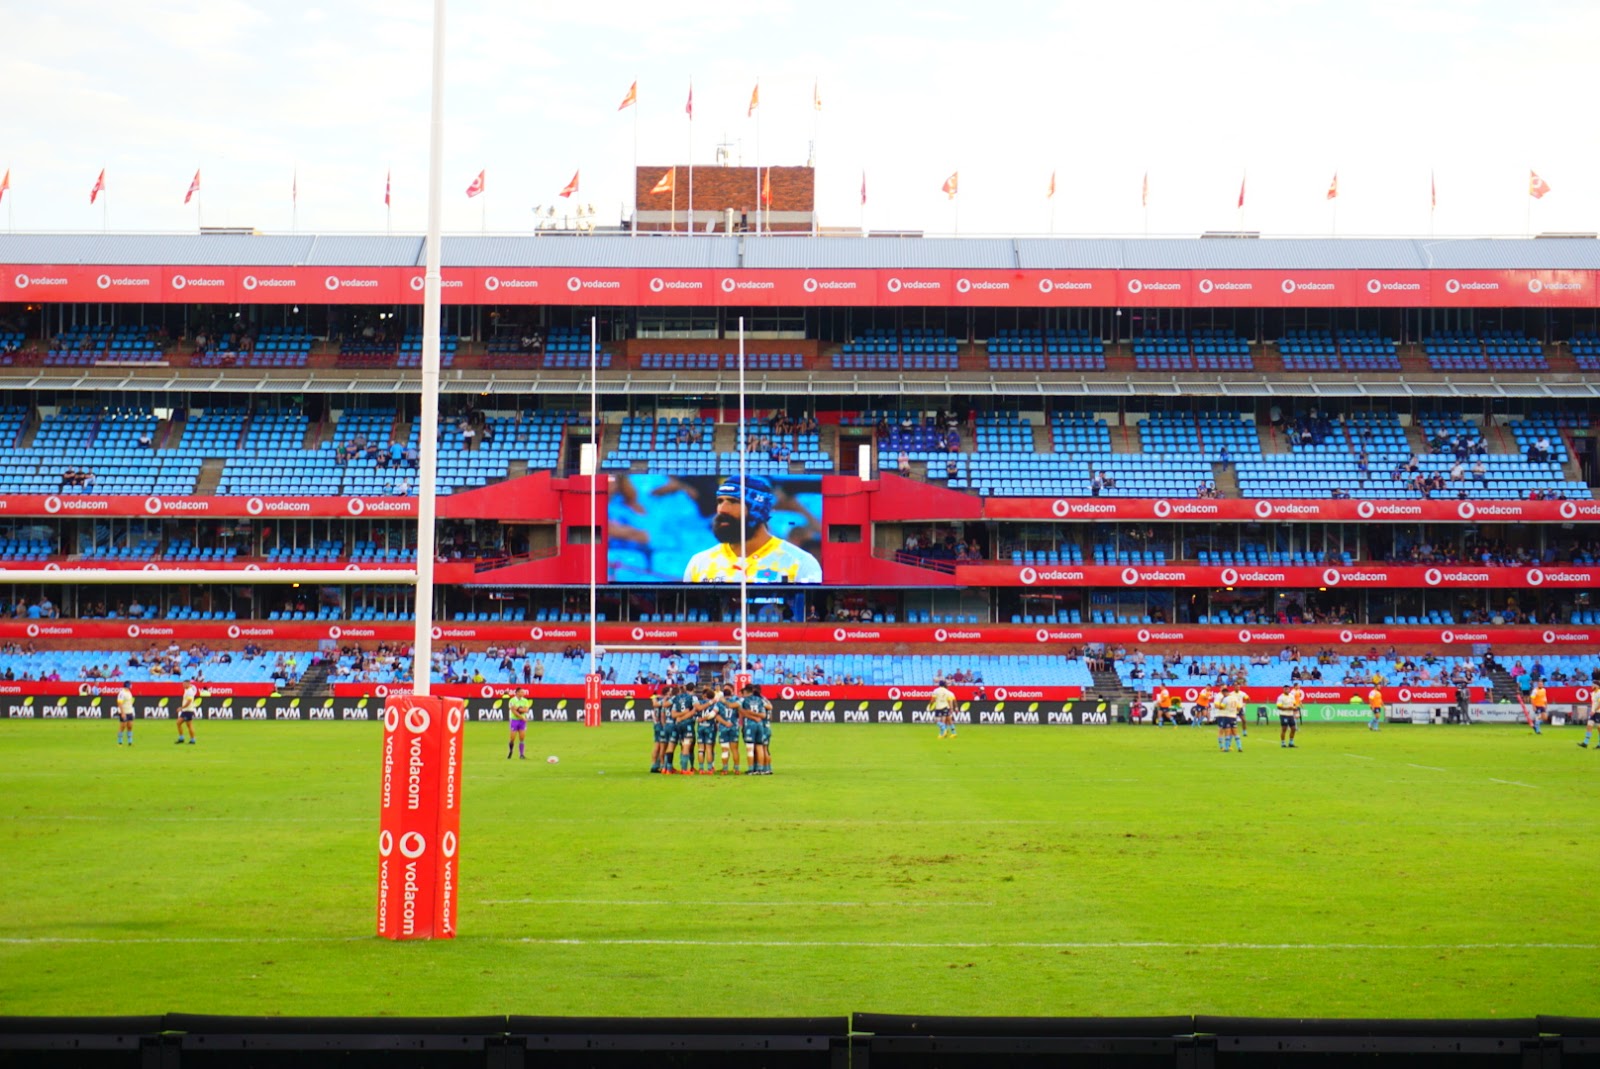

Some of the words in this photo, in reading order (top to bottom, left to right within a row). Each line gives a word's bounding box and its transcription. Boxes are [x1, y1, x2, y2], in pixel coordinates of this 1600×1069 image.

[30, 277, 68, 286] vodacom
[112, 277, 150, 286] vodacom
[187, 278, 225, 287] vodacom
[258, 278, 296, 288] vodacom
[340, 279, 378, 288] vodacom
[500, 280, 538, 288] vodacom
[582, 280, 620, 289] vodacom
[665, 280, 703, 290] vodacom
[736, 281, 775, 290] vodacom
[818, 281, 857, 290] vodacom
[902, 281, 941, 290] vodacom
[971, 282, 1010, 290] vodacom
[1053, 282, 1092, 291] vodacom
[1143, 282, 1181, 291] vodacom
[1214, 282, 1253, 291] vodacom
[1296, 282, 1335, 291] vodacom
[1382, 282, 1420, 291] vodacom
[1460, 282, 1499, 291] vodacom
[63, 500, 108, 510] vodacom
[162, 500, 208, 510] vodacom
[265, 501, 310, 510] vodacom
[365, 501, 411, 510] vodacom
[1071, 504, 1116, 513] vodacom
[1172, 504, 1218, 514] vodacom
[1273, 504, 1319, 514] vodacom
[1375, 504, 1422, 514] vodacom
[1476, 505, 1522, 514] vodacom
[1579, 505, 1600, 514] voda
[1038, 570, 1083, 579] vodacom
[1140, 570, 1185, 580] vodacom
[1240, 571, 1285, 581] vodacom
[1341, 572, 1387, 581] vodacom
[1443, 572, 1489, 581] vodacom
[1545, 572, 1590, 582] vodacom
[40, 627, 73, 635] vodacom
[140, 627, 173, 635] vodacom
[241, 628, 274, 636] vodacom
[342, 628, 375, 636] vodacom
[443, 628, 476, 636] vodacom
[544, 629, 577, 637] vodacom
[645, 630, 678, 638] vodacom
[746, 630, 779, 638] vodacom
[847, 630, 880, 638] vodacom
[948, 631, 981, 639] vodacom
[1050, 631, 1082, 639] vodacom
[1150, 631, 1184, 639] vodacom
[1252, 632, 1285, 640] vodacom
[1354, 632, 1386, 640] vodacom
[1454, 632, 1488, 640] vodacom
[1556, 633, 1589, 641] vodacom
[10, 706, 34, 717] PVM
[43, 706, 68, 717] PVM
[77, 706, 101, 717] PVM
[144, 707, 169, 718] PVM
[208, 707, 233, 718] PVM
[242, 708, 266, 718] PVM
[276, 708, 300, 718] PVM
[310, 708, 334, 719] PVM
[343, 708, 368, 719] PVM
[479, 709, 503, 720] PVM
[542, 709, 568, 720] PVM
[610, 710, 635, 721] PVM
[780, 711, 804, 721] PVM
[810, 711, 835, 721] PVM
[844, 711, 869, 722] PVM
[878, 711, 903, 722] PVM
[980, 711, 1005, 722] PVM
[1014, 712, 1039, 722] PVM
[1048, 712, 1073, 723] PVM
[1082, 712, 1106, 723] PVM
[384, 736, 394, 808] vodacom
[408, 736, 424, 809] vodacom
[447, 737, 456, 808] vodacom
[379, 860, 388, 933] vodacom
[403, 862, 418, 935] vodacom
[442, 861, 452, 933] vodacom
